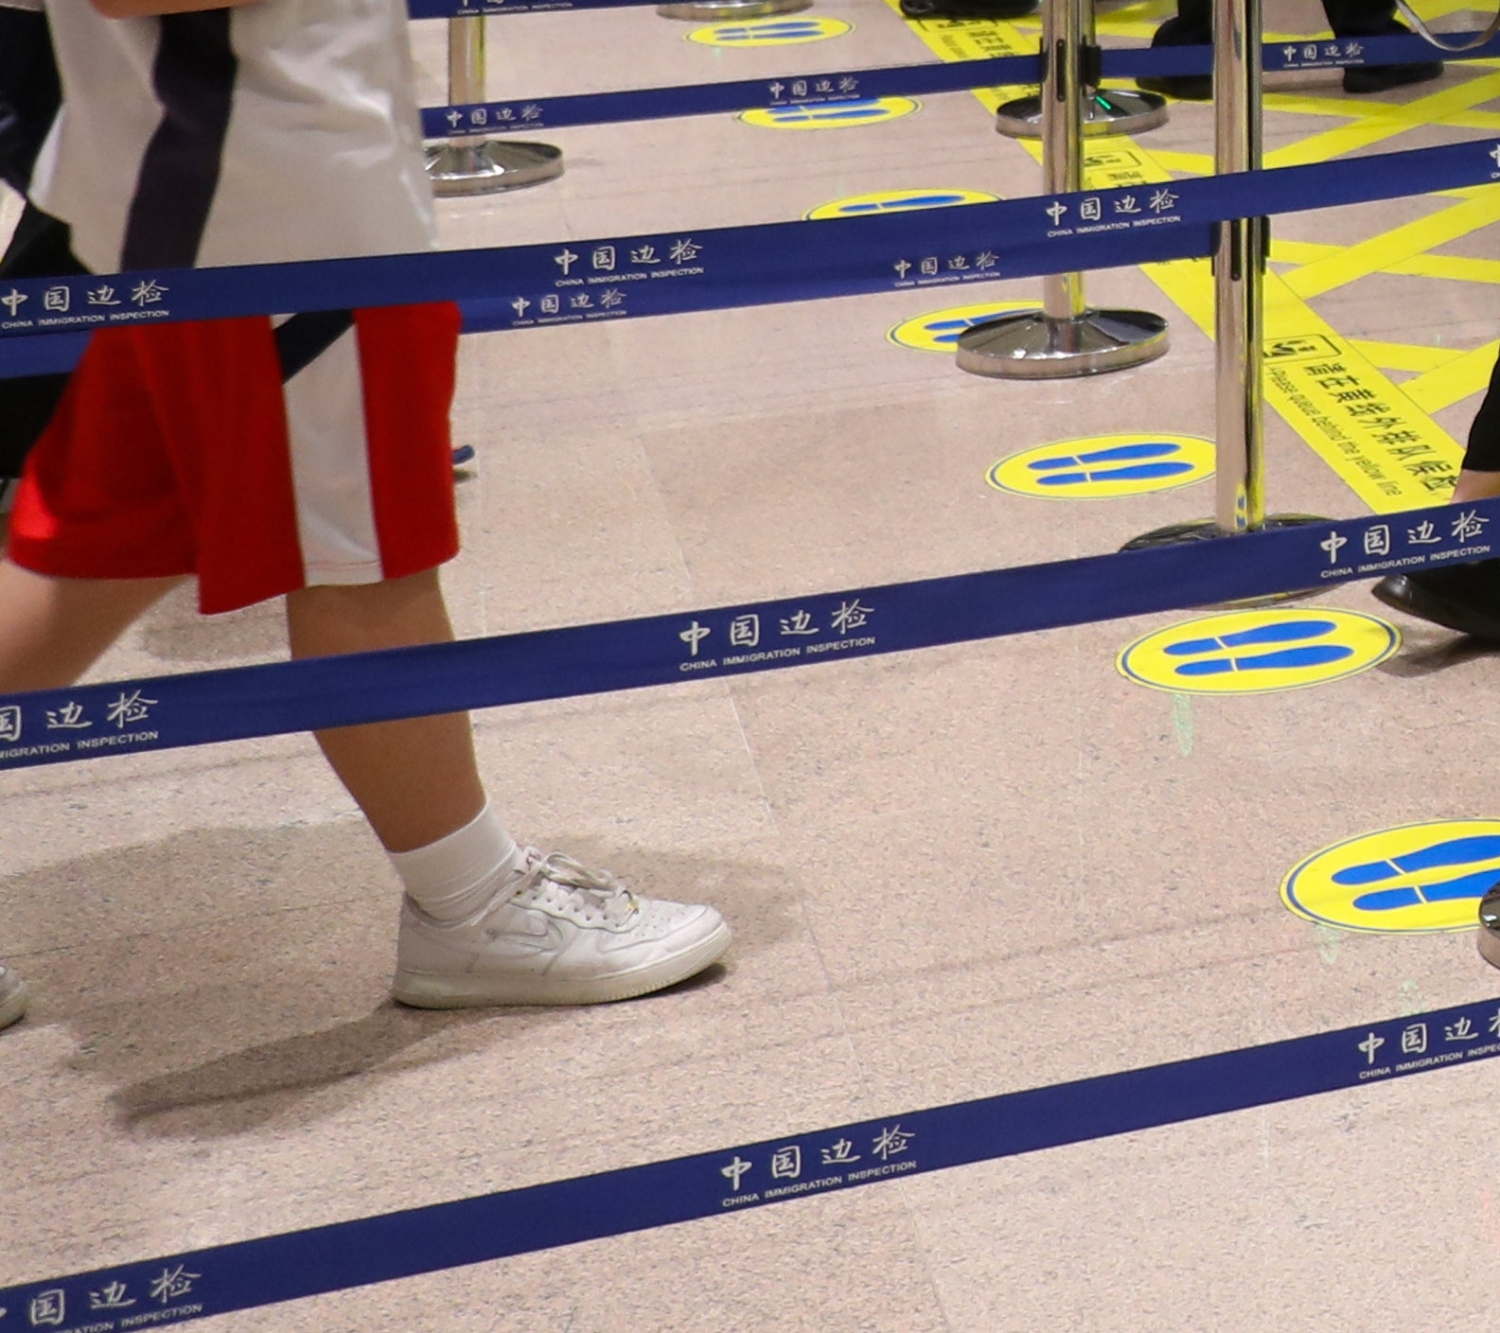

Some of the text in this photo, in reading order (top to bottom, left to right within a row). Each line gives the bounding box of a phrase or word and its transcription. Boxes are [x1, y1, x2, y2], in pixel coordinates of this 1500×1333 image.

[1284, 42, 1364, 62] 中国边检
[769, 76, 860, 99] 中国边检
[446, 104, 544, 128] 中国边检
[1045, 188, 1179, 226] 中国边检
[1047, 215, 1181, 238] CHINA IMMIGRATION INSPECTION
[554, 238, 703, 275] 中国边检
[894, 251, 999, 279] 中国边检
[555, 267, 704, 288] CHINA IMMIGRATION INSPECTION
[1, 279, 169, 317] 中国边检
[511, 288, 627, 318] 中国边检
[1, 309, 170, 329] CHINA IMMIGRATION INSPECTION
[1315, 415, 1346, 443] behind
[1337, 436, 1360, 455] the
[1353, 451, 1386, 481] yellow
[1377, 474, 1403, 496] line
[1320, 508, 1490, 565] 中国边检
[1320, 545, 1491, 579] CHINA IMMIGRATION INSPECTION
[678, 597, 874, 655] 中国边检
[679, 635, 876, 671] CHINA IMMIGRATION INSPECTION
[76, 730, 159, 752] INSPECTION
[1359, 1067, 1391, 1080] CHINA
[1396, 1052, 1463, 1073] IMMIGRATION
[720, 1124, 914, 1191] 中国边检
[722, 1160, 917, 1208] CHINA IMMIGRATION INSPECTION
[0, 1264, 201, 1326] 国边检
[121, 1304, 203, 1329] INSPECTION
